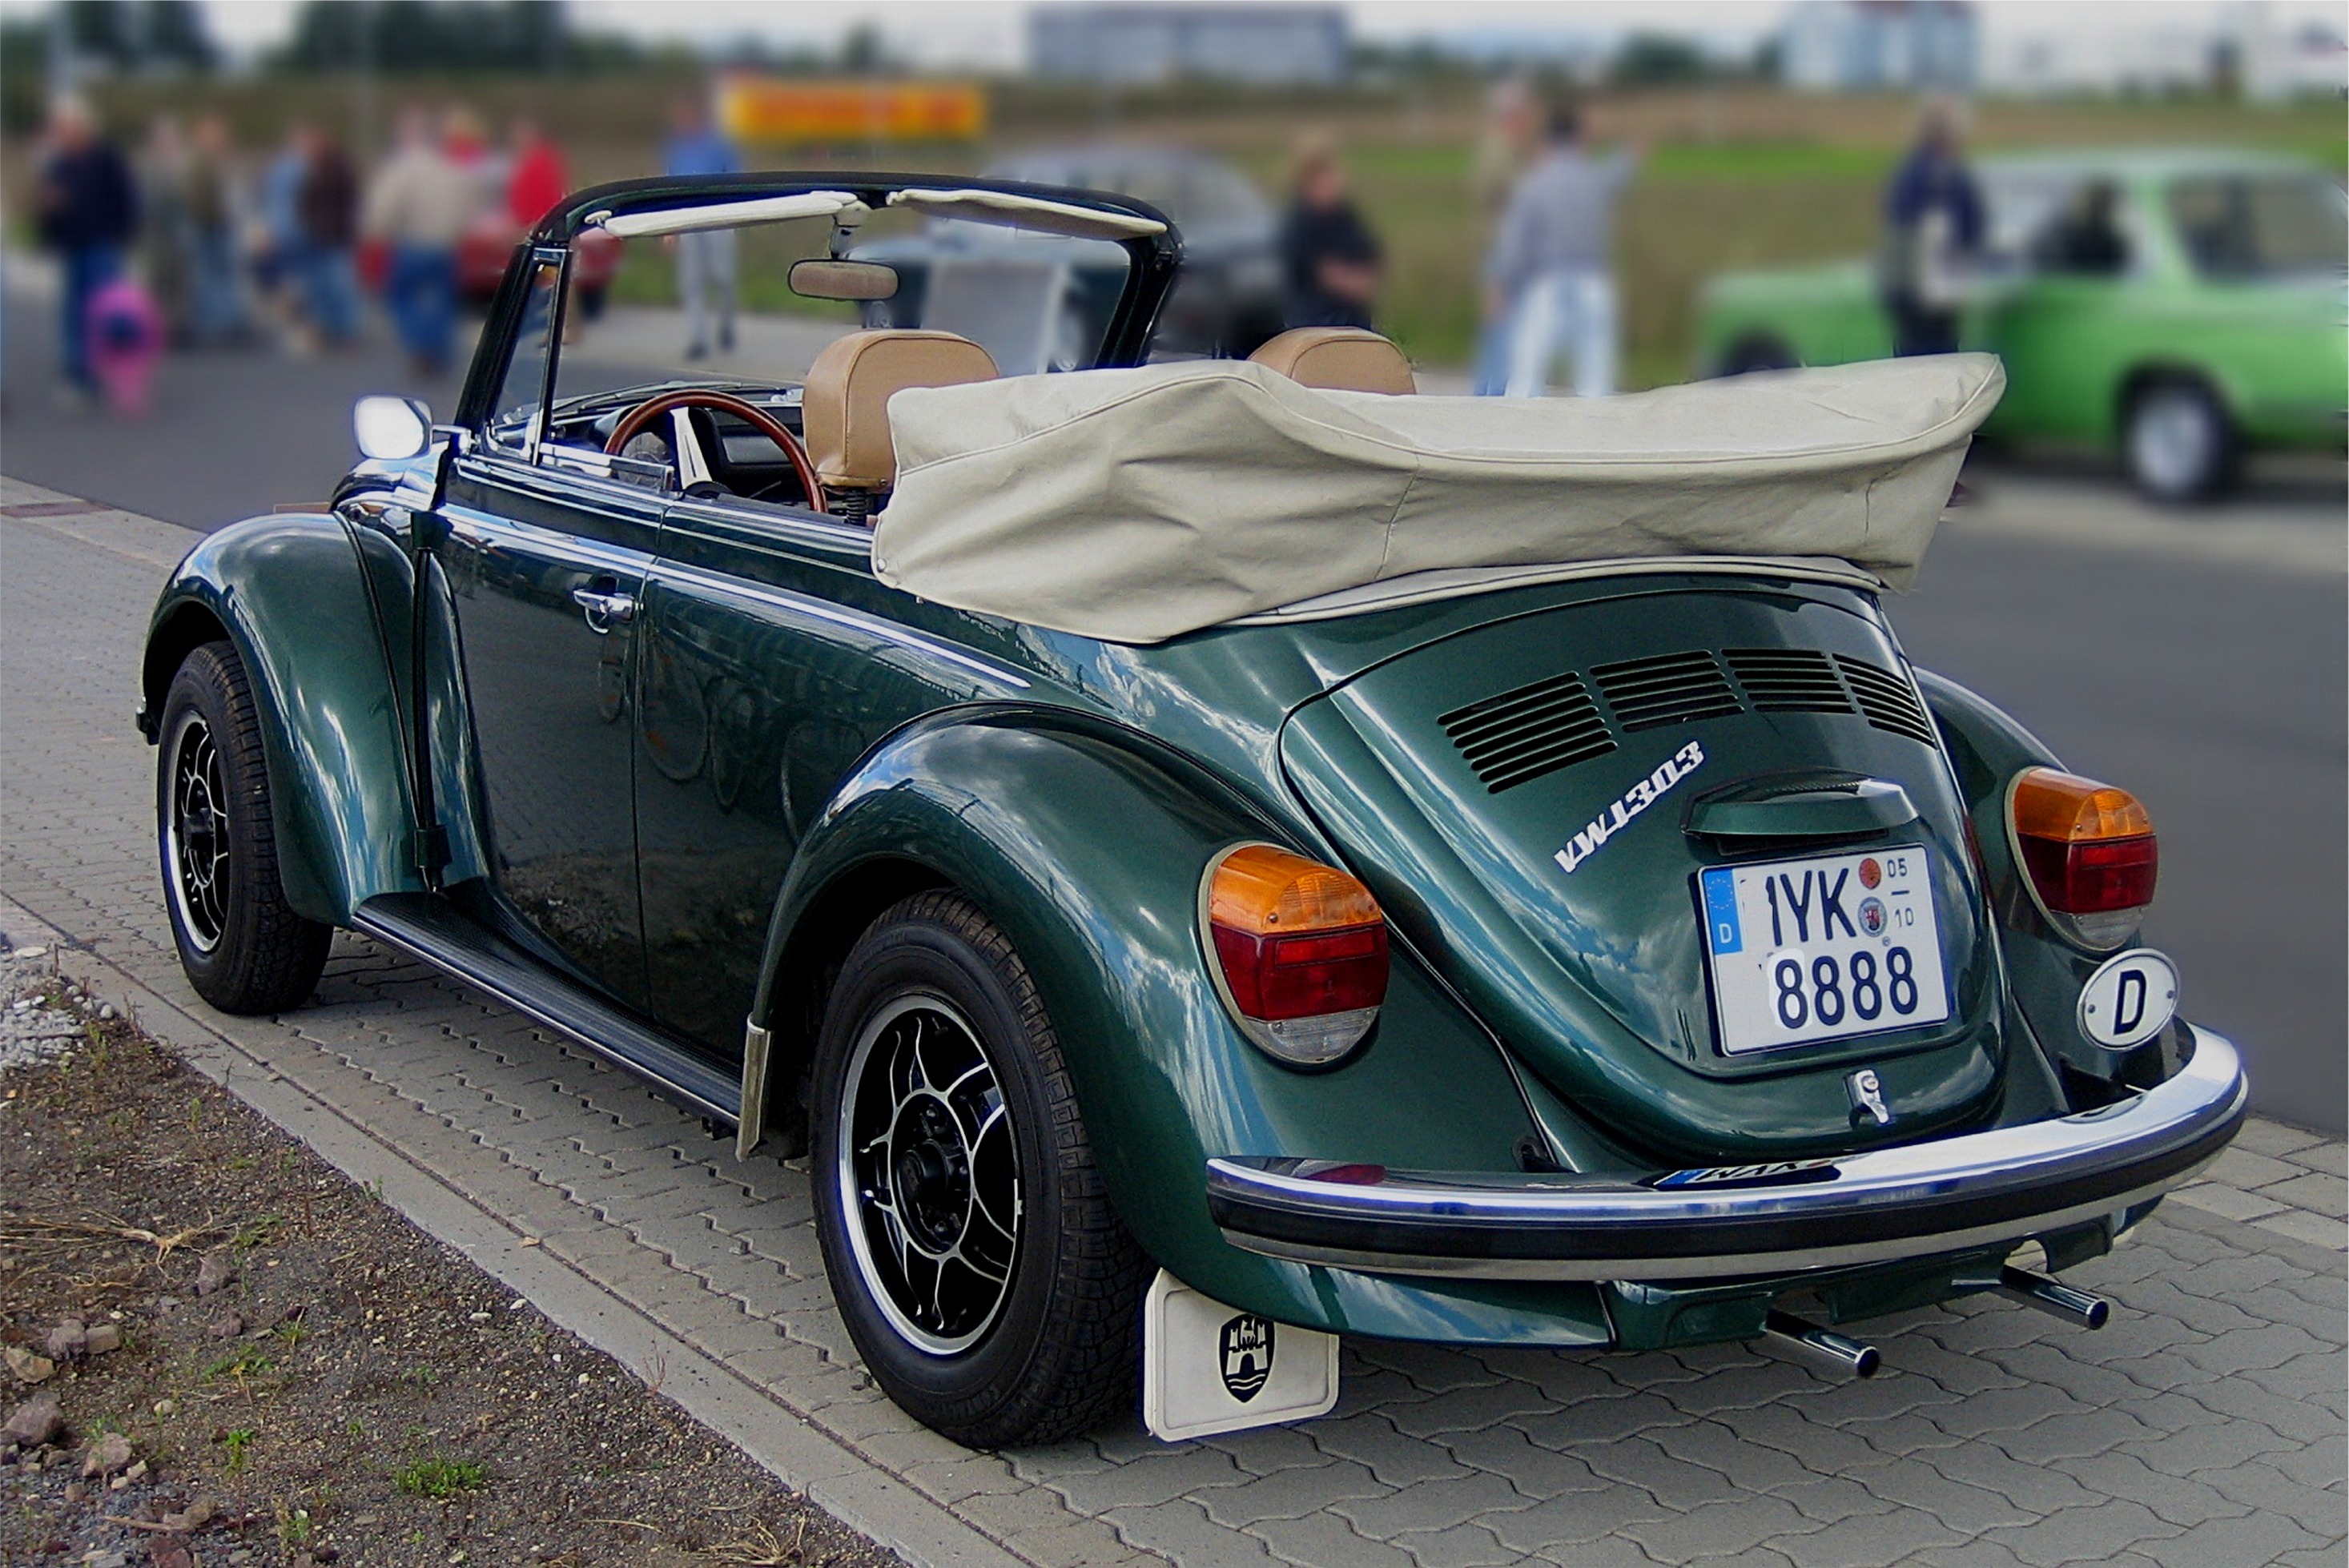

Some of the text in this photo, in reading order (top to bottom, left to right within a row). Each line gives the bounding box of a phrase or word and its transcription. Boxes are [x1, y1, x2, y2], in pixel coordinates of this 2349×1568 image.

[1887, 858, 1908, 878] 05
[1894, 907, 1915, 928] 10
[1719, 923, 1733, 943] D
[1775, 946, 1918, 1030] 8888
[2113, 969, 2147, 1035] D
